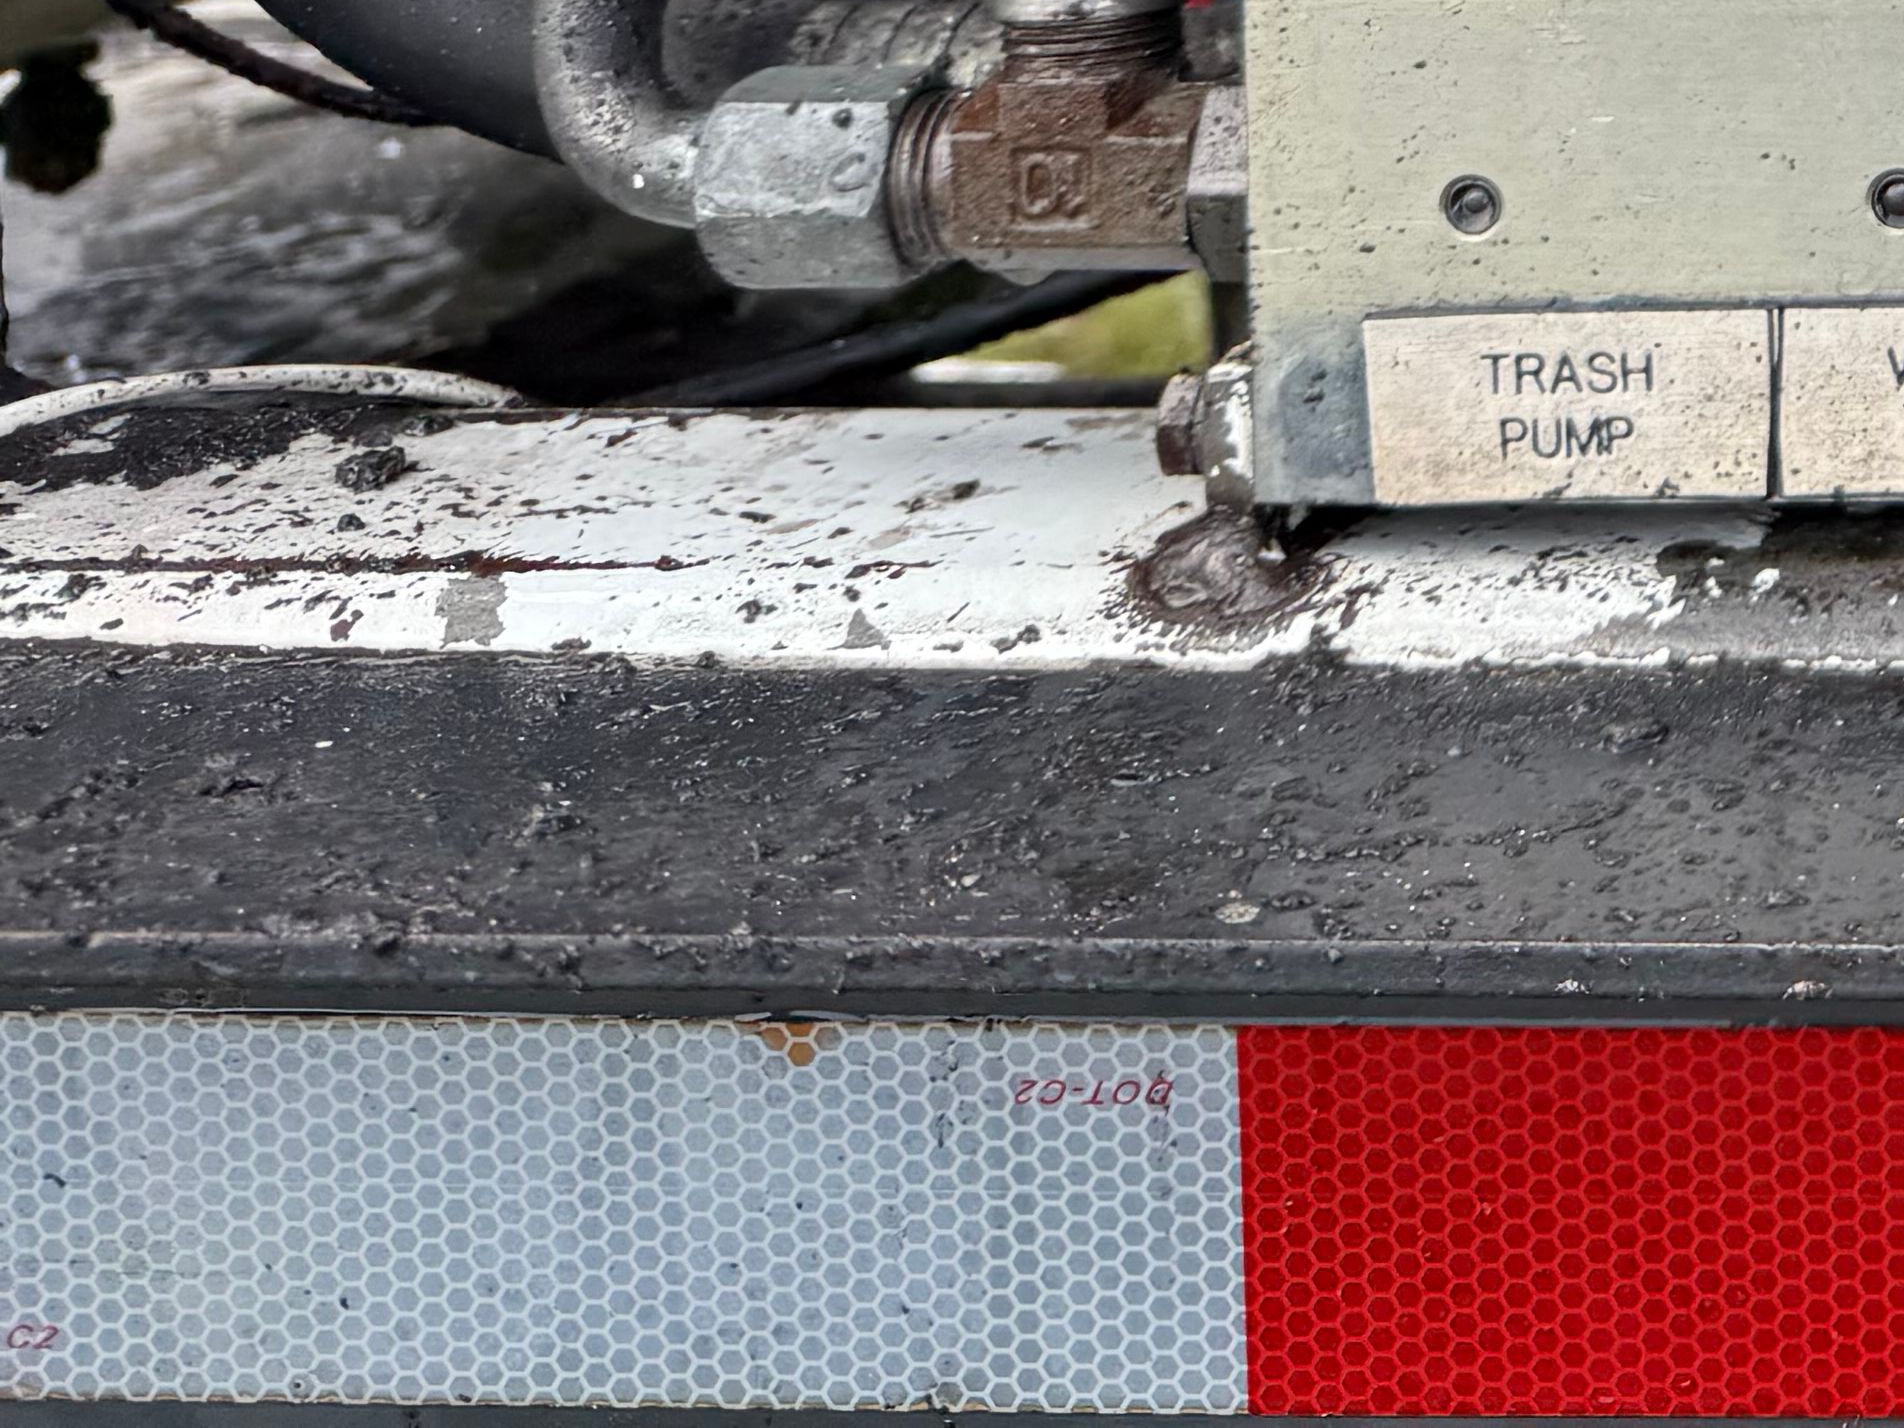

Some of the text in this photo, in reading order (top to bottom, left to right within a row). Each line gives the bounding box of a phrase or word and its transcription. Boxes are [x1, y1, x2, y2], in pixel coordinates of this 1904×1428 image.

[1480, 350, 1653, 395] TRASH
[1500, 415, 1634, 460] PUMP
[1015, 1079, 1174, 1106] DOT-C2
